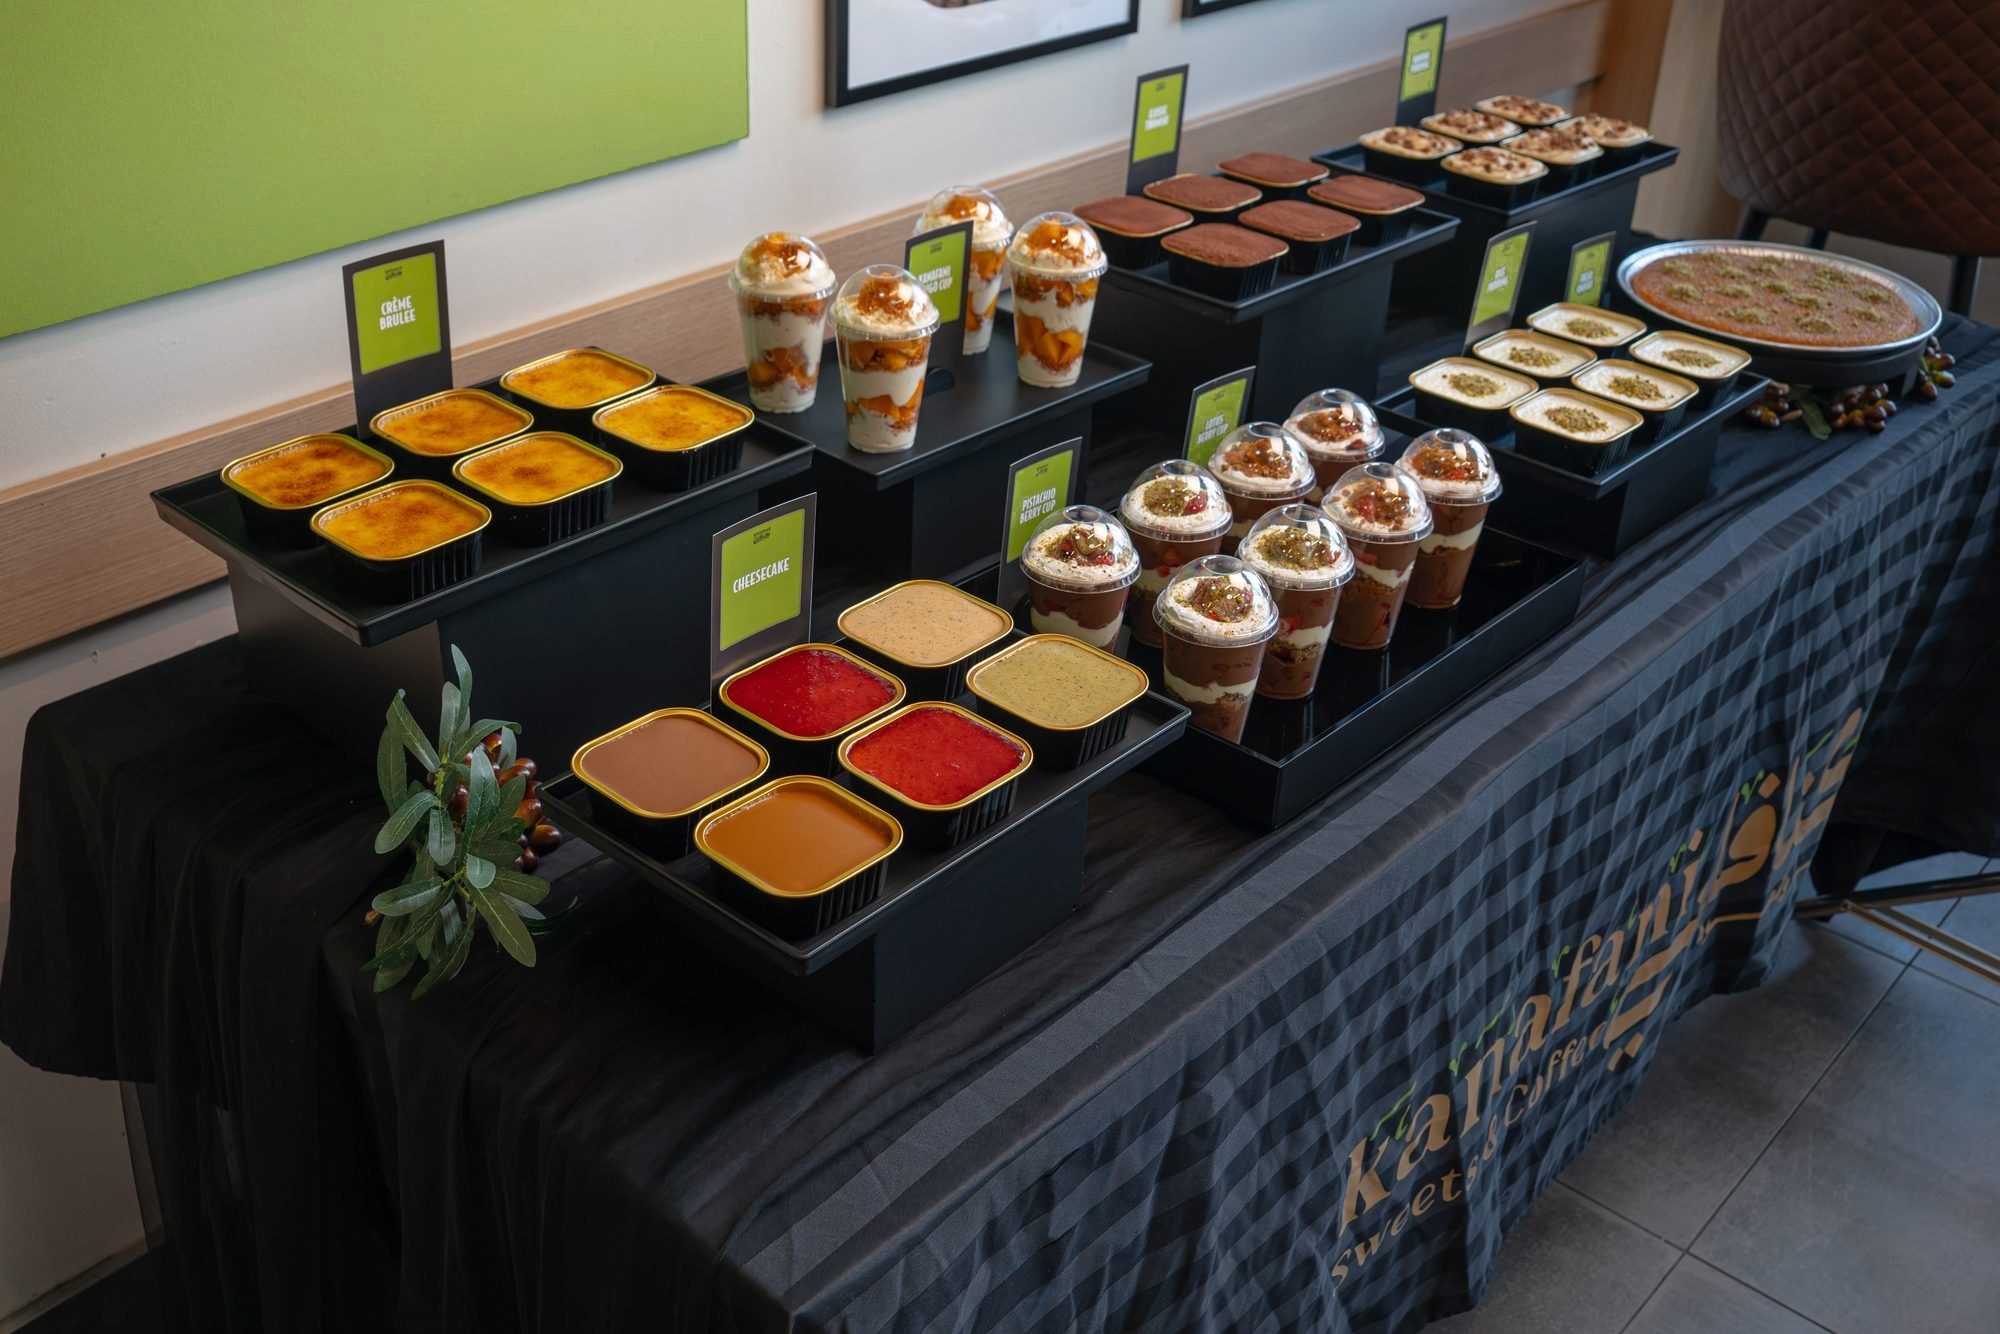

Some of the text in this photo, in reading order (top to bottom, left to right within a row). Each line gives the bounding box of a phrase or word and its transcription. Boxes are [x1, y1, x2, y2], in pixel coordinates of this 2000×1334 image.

[380, 308, 416, 331] BRULEE
[1020, 499, 1056, 524] BERRY CUP
[1022, 487, 1057, 512] PISTACHIO
[733, 557, 790, 594] CHEESECAKE
[1331, 1155, 1480, 1299] sweets
